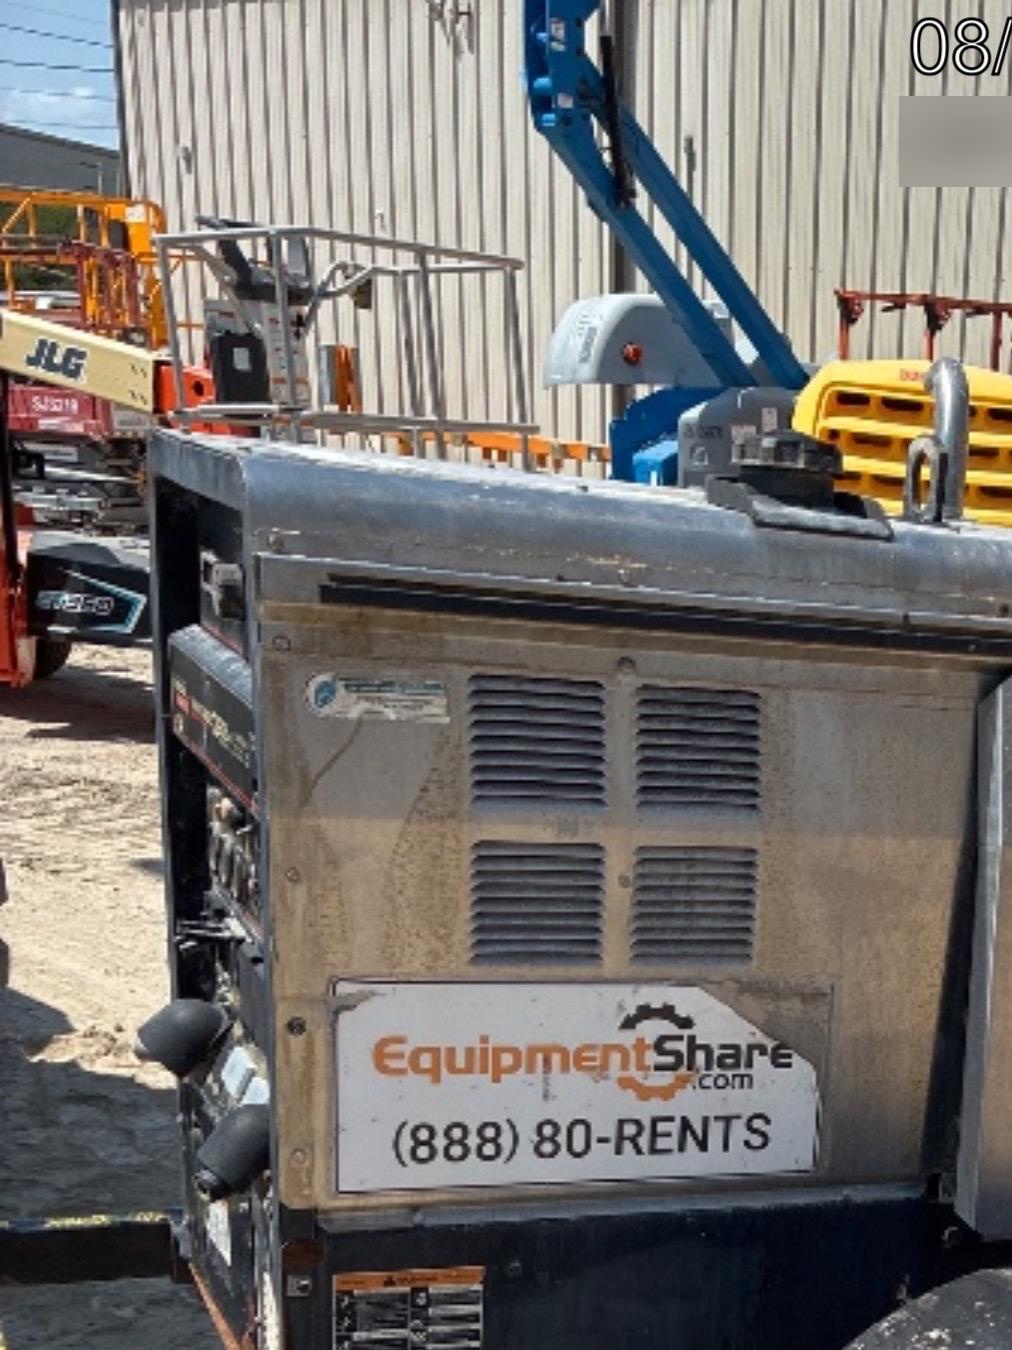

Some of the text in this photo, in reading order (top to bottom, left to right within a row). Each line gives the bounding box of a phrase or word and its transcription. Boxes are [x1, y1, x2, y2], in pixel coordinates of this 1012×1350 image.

[26, 338, 87, 380] JLG
[371, 1034, 795, 1085] EquipmentShare
[692, 1072, 754, 1091] .com
[392, 1112, 773, 1167] (888) 80-RENTS
